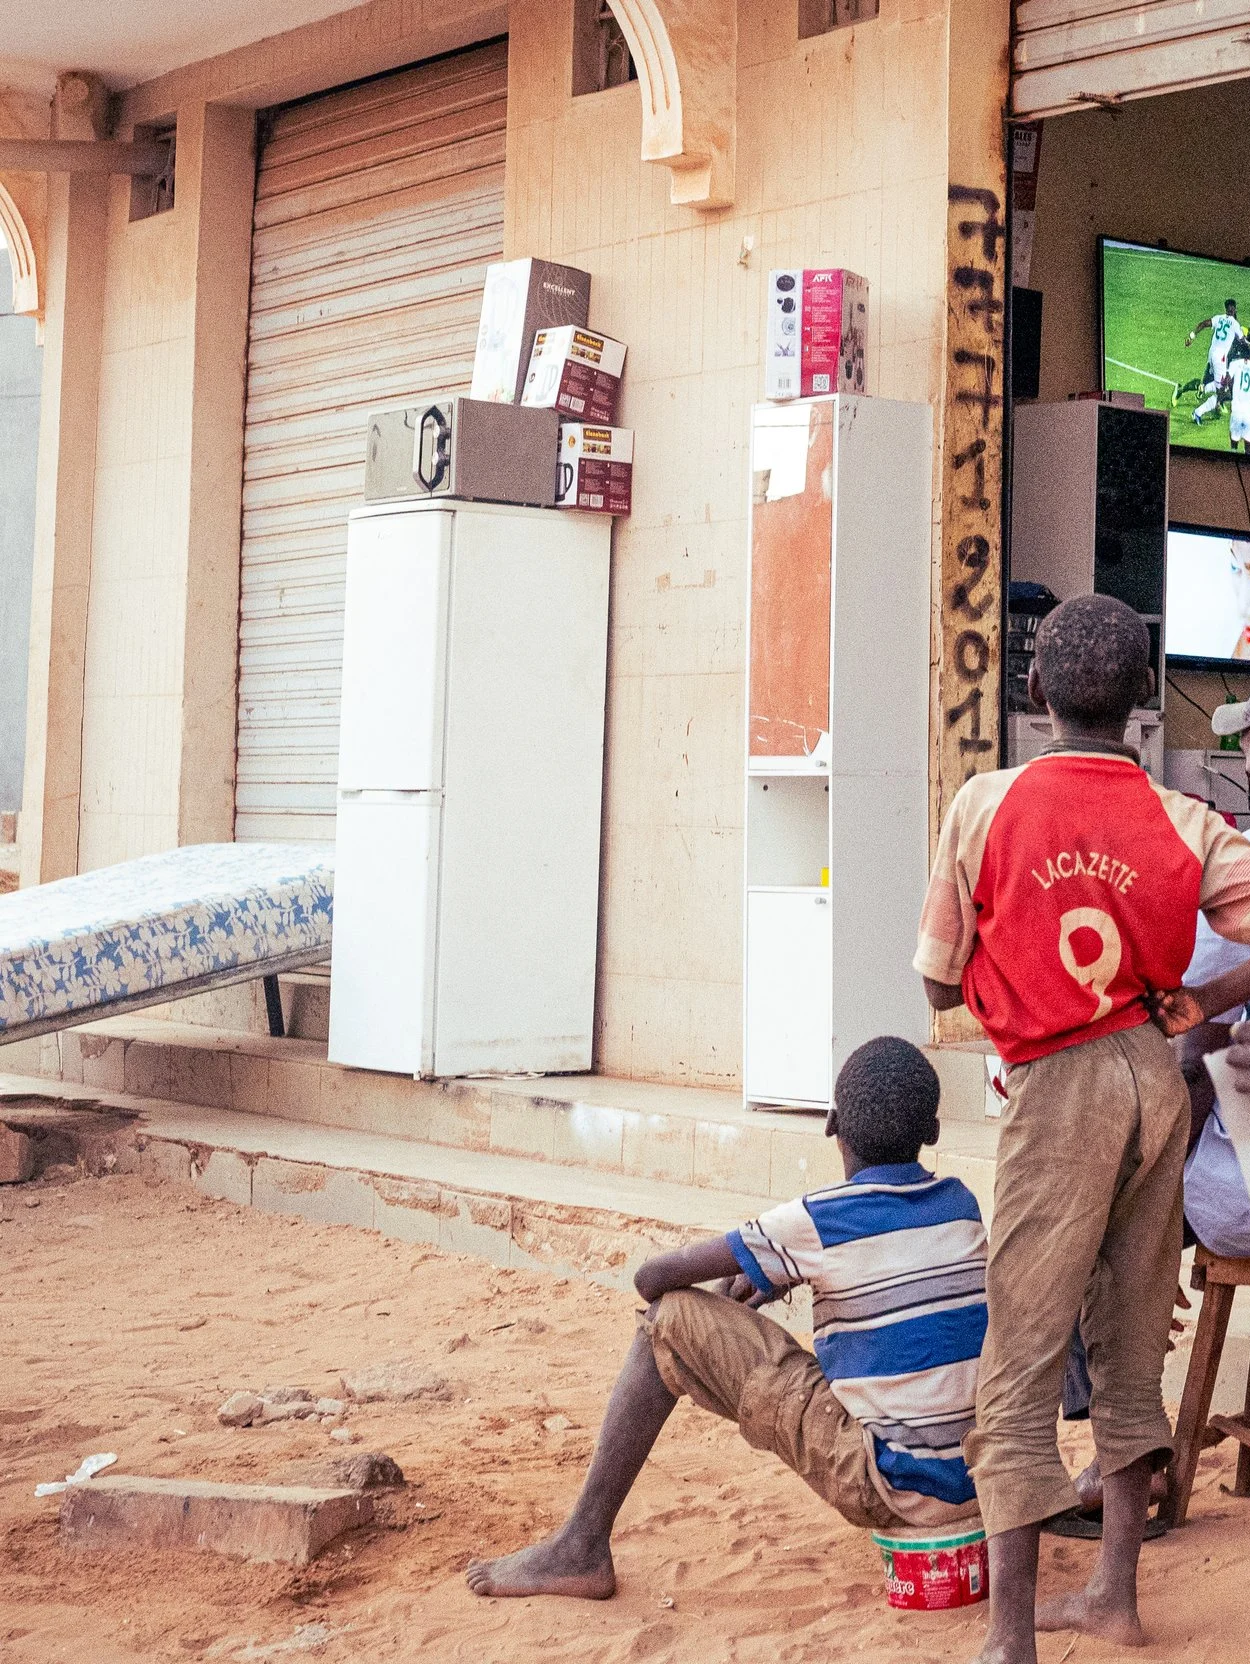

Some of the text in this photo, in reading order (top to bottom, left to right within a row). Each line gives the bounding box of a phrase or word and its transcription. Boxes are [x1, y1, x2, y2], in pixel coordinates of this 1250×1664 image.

[543, 281, 576, 296] EXCELLENT
[1215, 321, 1231, 341] 25
[1239, 371, 1250, 393] 19
[1031, 851, 1140, 894] LACAZETTE
[1058, 906, 1122, 1022] 9
